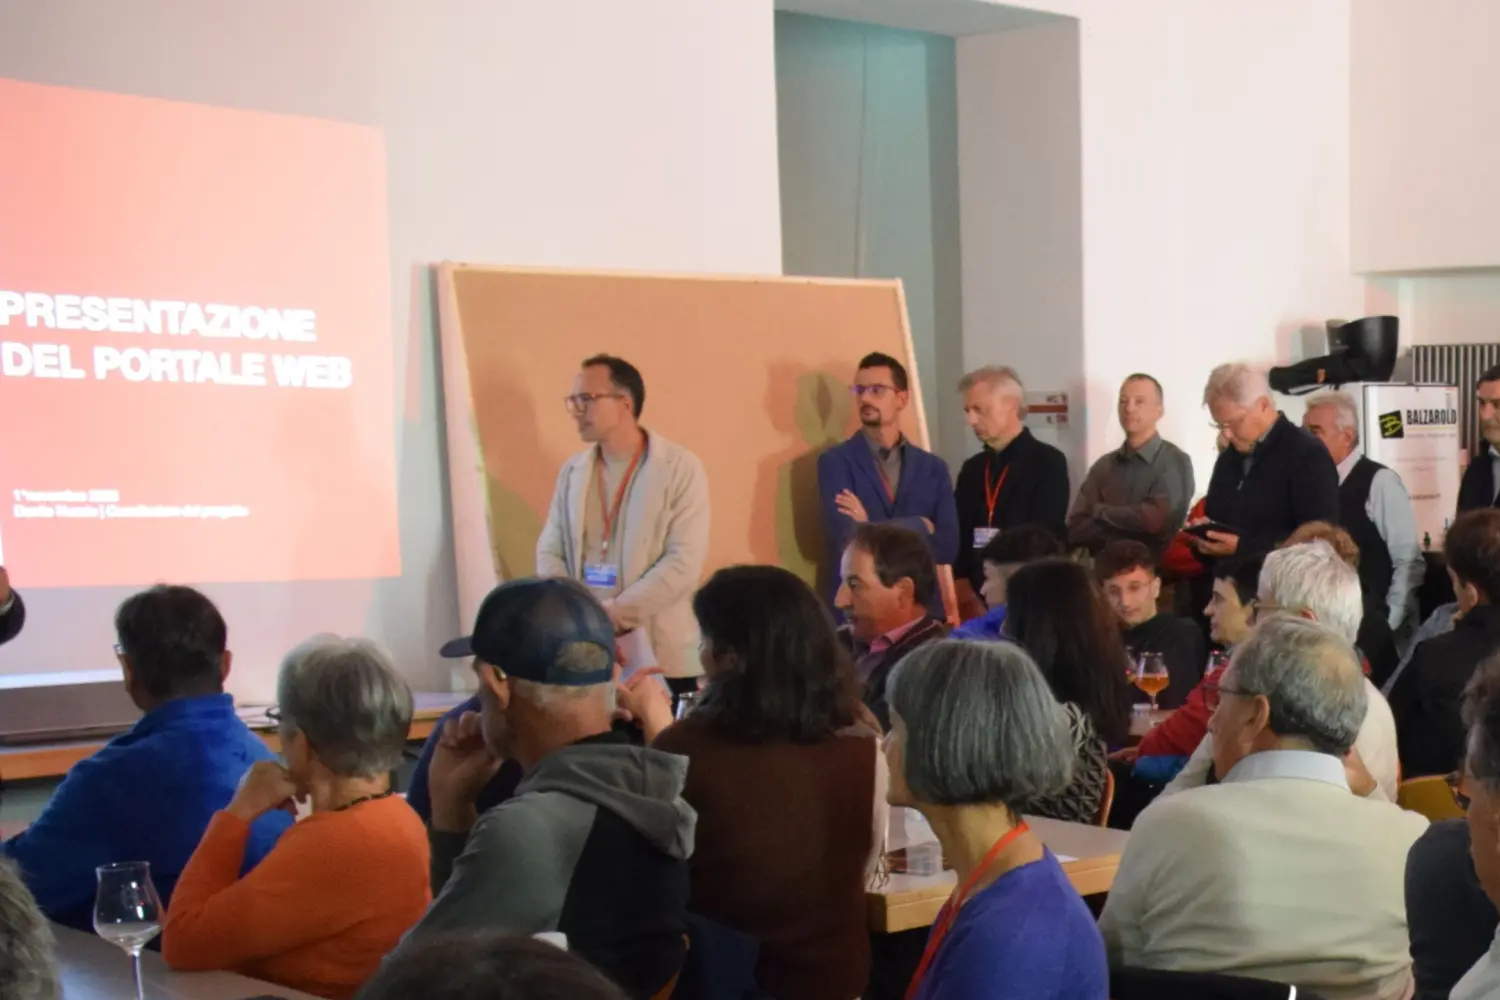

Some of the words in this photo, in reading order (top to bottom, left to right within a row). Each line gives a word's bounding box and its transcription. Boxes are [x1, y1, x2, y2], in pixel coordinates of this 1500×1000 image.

[0, 291, 317, 342] PRESENTAZIONE
[2, 341, 86, 379] DEL
[93, 345, 267, 386] PORTALE
[273, 353, 353, 389] WEB
